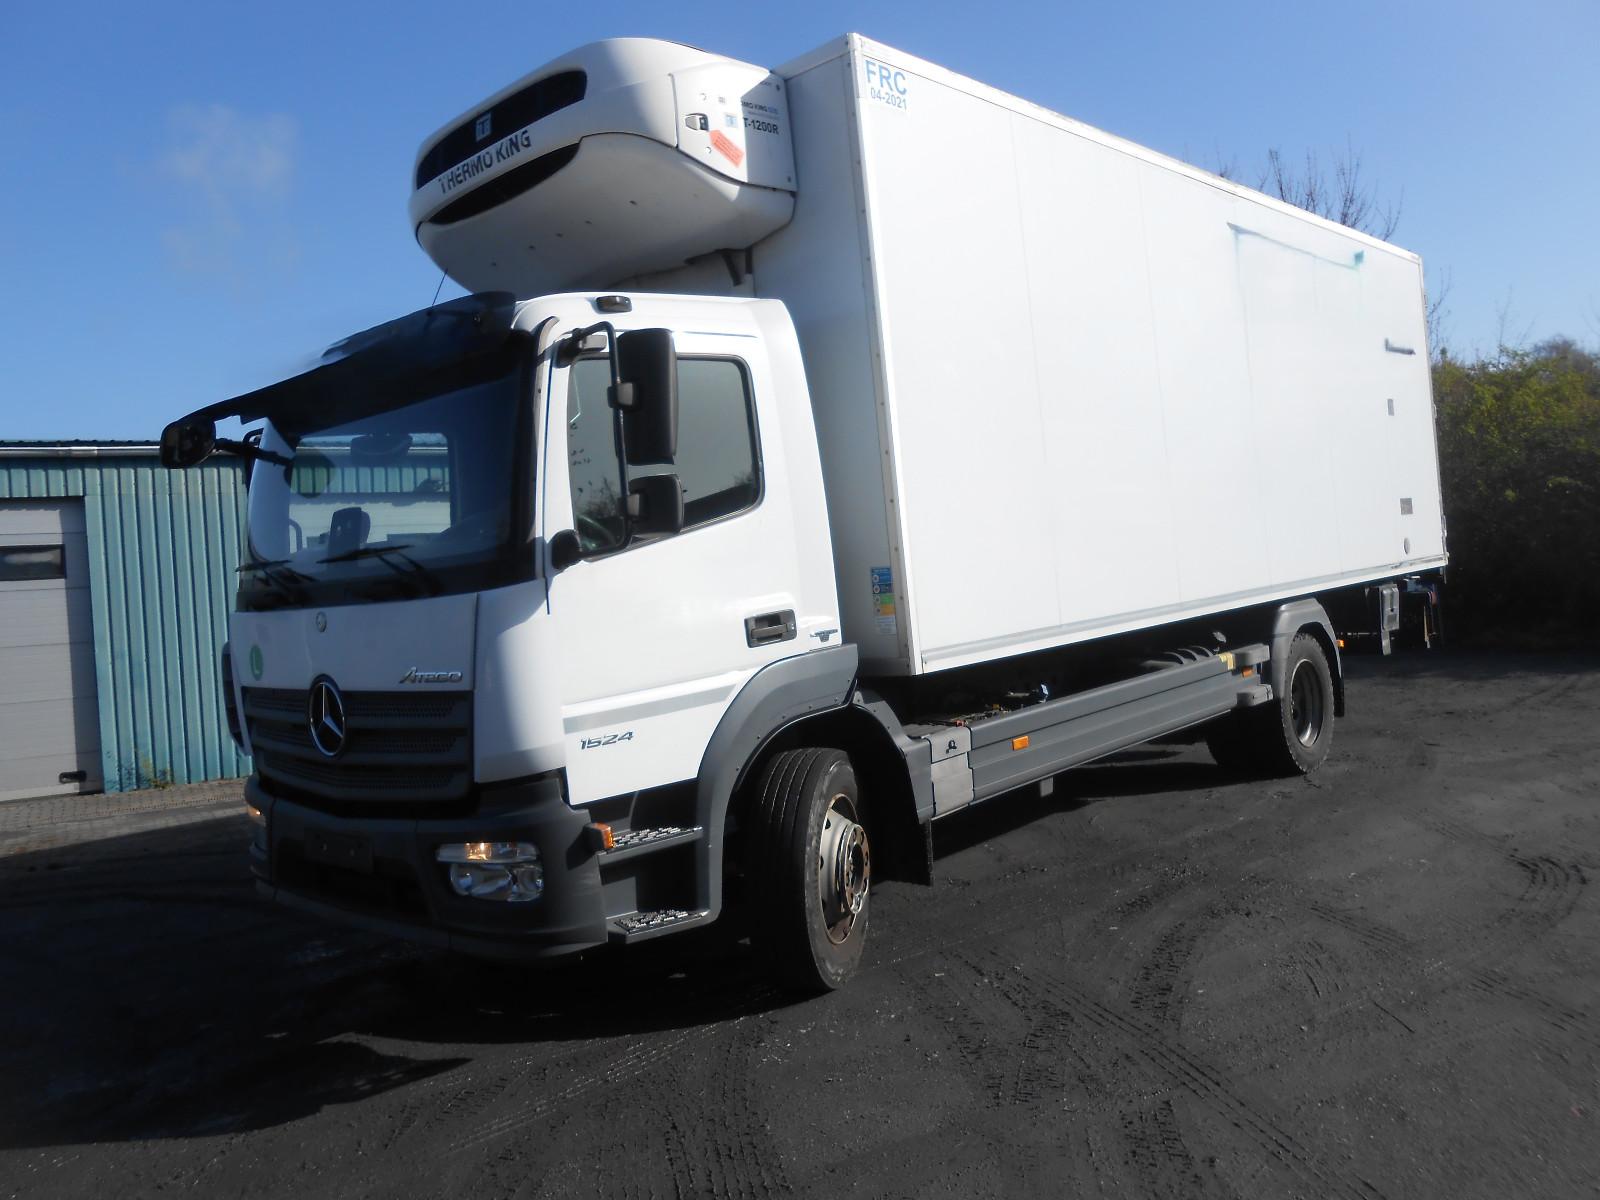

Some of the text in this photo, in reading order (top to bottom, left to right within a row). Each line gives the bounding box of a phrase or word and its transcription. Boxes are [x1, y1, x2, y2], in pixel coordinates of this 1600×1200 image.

[865, 60, 907, 95] FRC
[871, 87, 907, 110] 04-2021
[438, 129, 531, 194] THERMO KING
[580, 731, 634, 750] 1524
